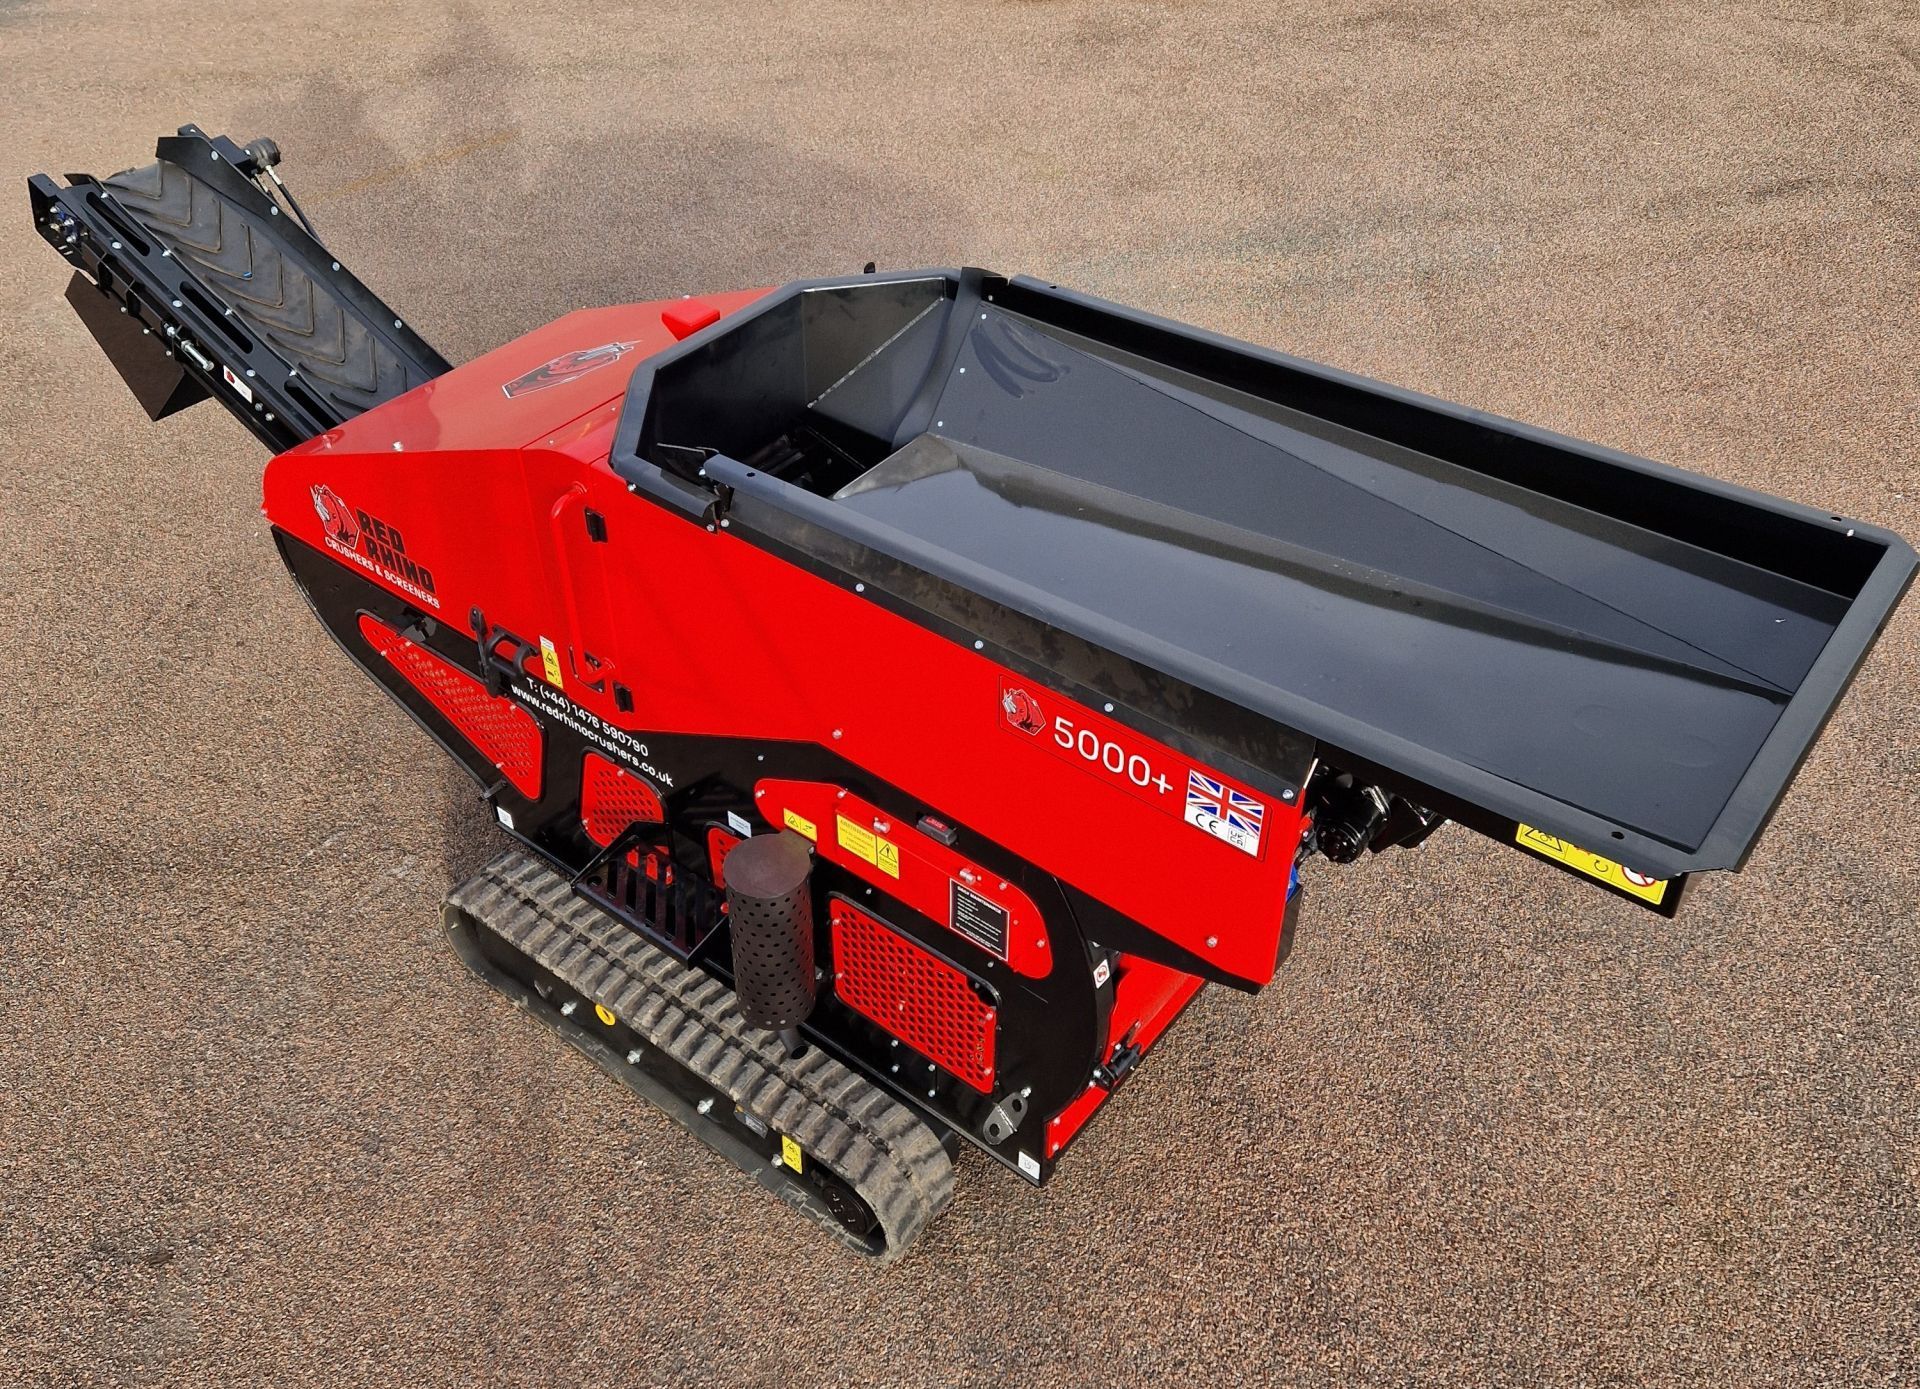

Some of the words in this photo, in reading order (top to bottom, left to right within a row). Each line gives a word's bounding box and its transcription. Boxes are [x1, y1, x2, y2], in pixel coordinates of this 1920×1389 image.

[355, 508, 405, 555] RED
[363, 535, 436, 594] RHINO
[325, 537, 374, 571] CRUSHERS
[375, 565, 383, 577] &
[384, 570, 440, 609] SCREENERS
[511, 685, 674, 788] www.redrhinocrushers.co.uk
[527, 677, 538, 692] T:
[540, 685, 570, 713] (+44)
[571, 704, 599, 729] 1476
[602, 722, 649, 757] 590790
[1054, 716, 1174, 794] 5000+
